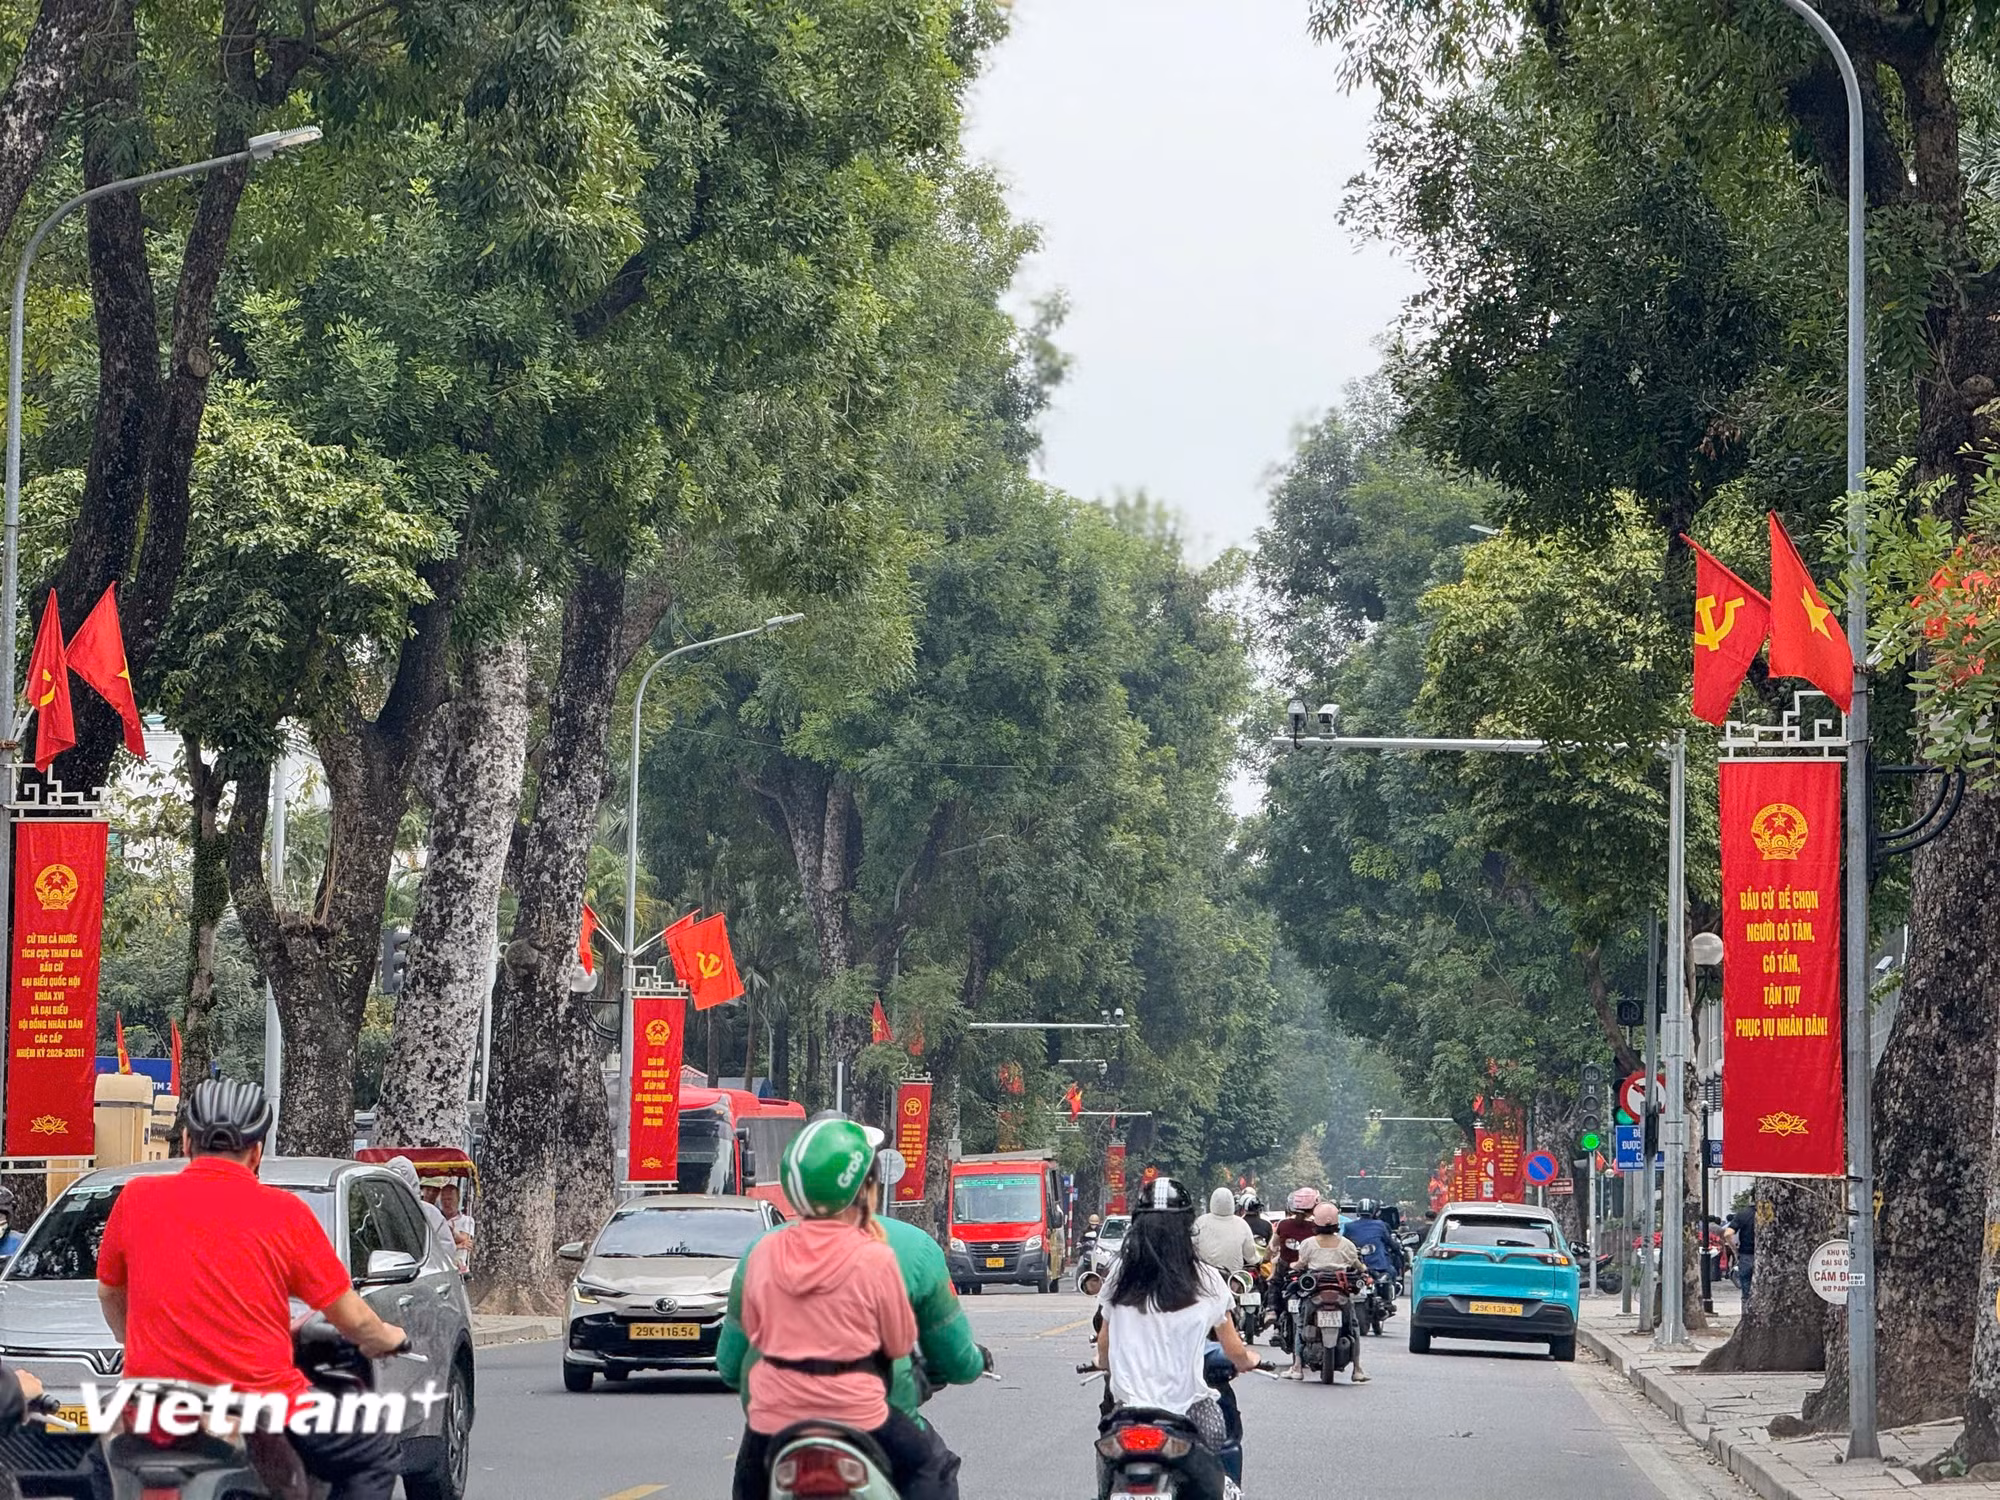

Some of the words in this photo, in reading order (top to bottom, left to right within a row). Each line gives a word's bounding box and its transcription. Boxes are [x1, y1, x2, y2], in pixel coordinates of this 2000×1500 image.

[1793, 891, 1819, 913] CHỌN
[1746, 919, 1775, 942] NGƯỜI
[1777, 919, 1790, 941] CÓ
[1792, 919, 1815, 943] TÂM,
[1763, 951, 1776, 973] CÓ
[1763, 982, 1782, 1009] TẬN
[1736, 1018, 1760, 1041] PHỤC
[1763, 1018, 1775, 1040] VỤ
[1777, 1013, 1803, 1036] NHÂN
[1805, 1013, 1828, 1036] DÂN!
[152, 1081, 164, 1090] TM
[837, 1151, 864, 1188] Grab
[1814, 1269, 1836, 1281] CẤM
